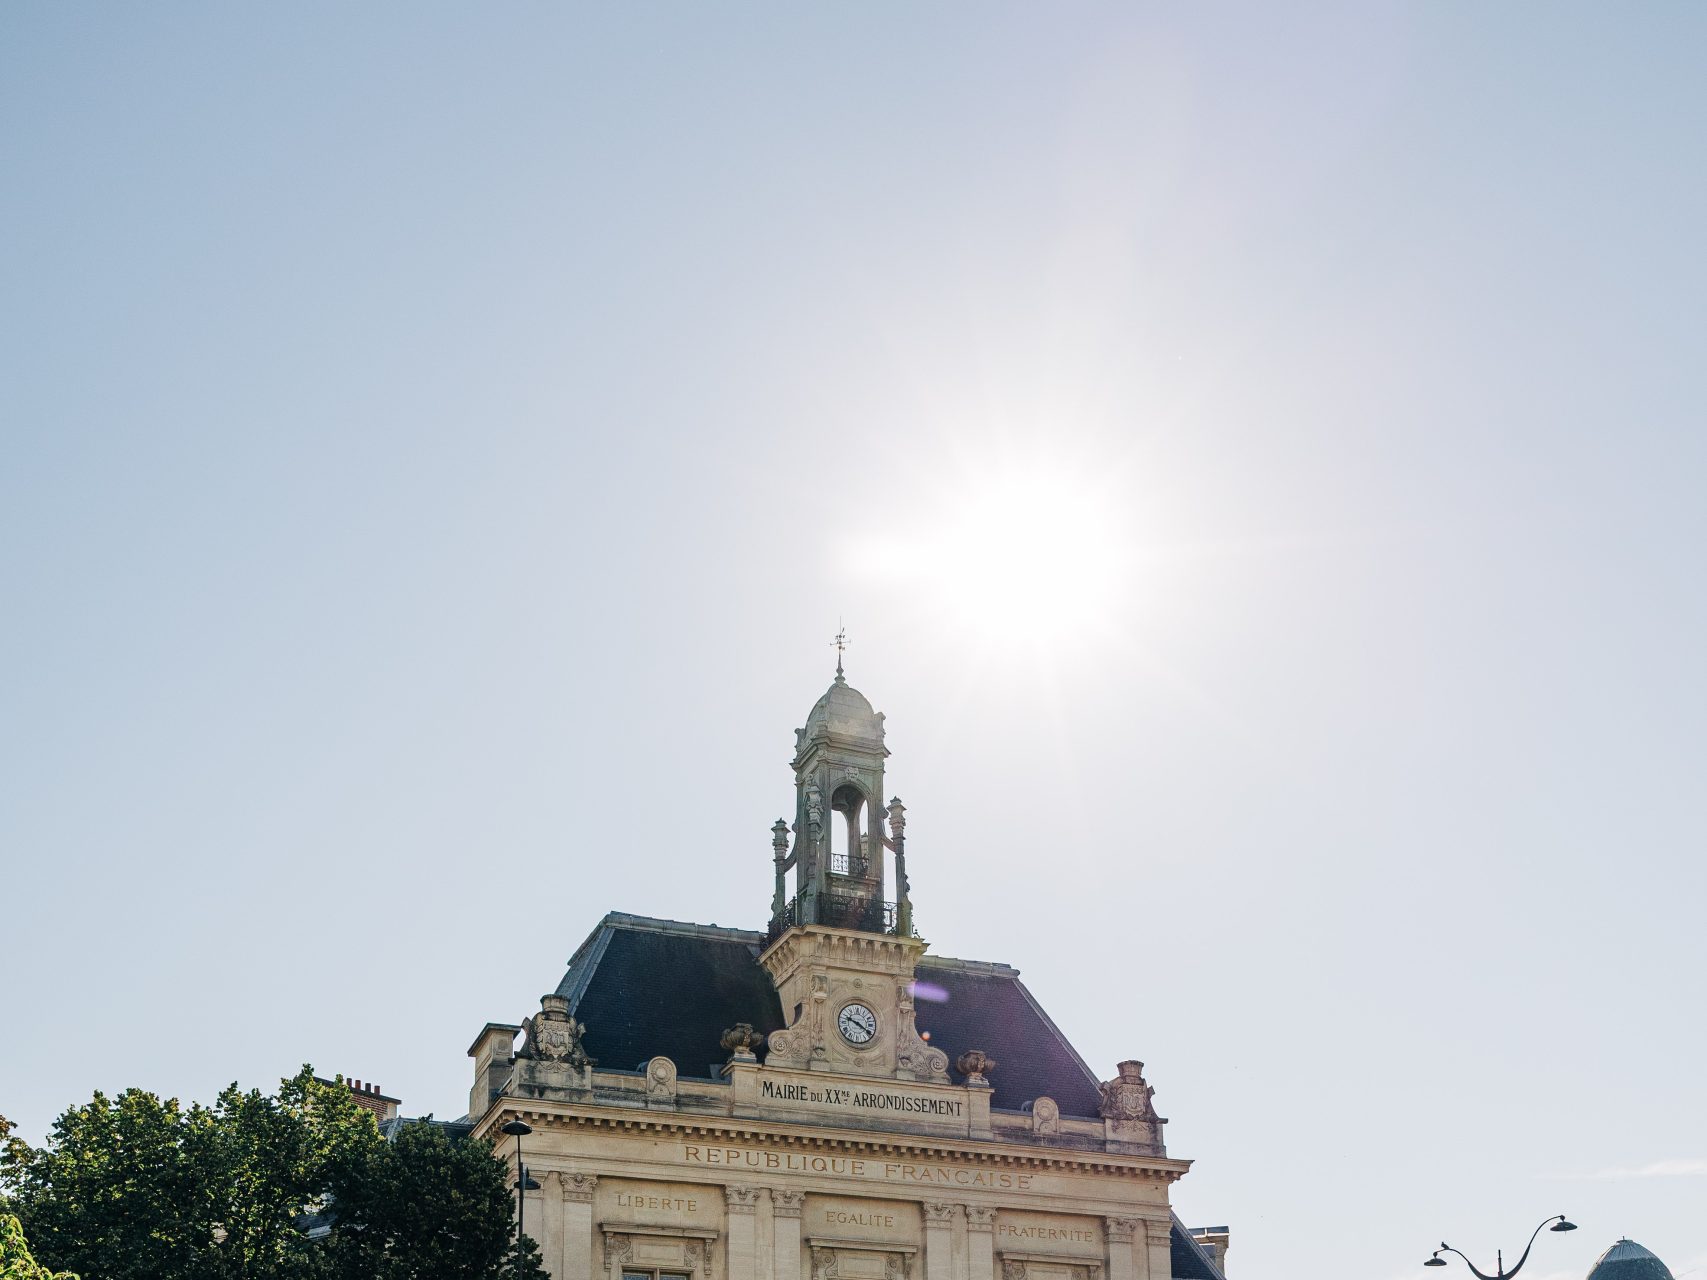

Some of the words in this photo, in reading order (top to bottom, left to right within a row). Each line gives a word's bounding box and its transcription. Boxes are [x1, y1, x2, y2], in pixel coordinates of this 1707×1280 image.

[762, 1080, 808, 1101] MAIRIE
[811, 1092, 823, 1102] DU
[852, 1092, 962, 1116] ARRONDISSEMENT
[685, 1146, 865, 1176] REPUBLIQUE
[617, 1194, 697, 1212] LIBERTE
[826, 1211, 894, 1228] EGALITE
[998, 1224, 1093, 1242] FRATERNITE
